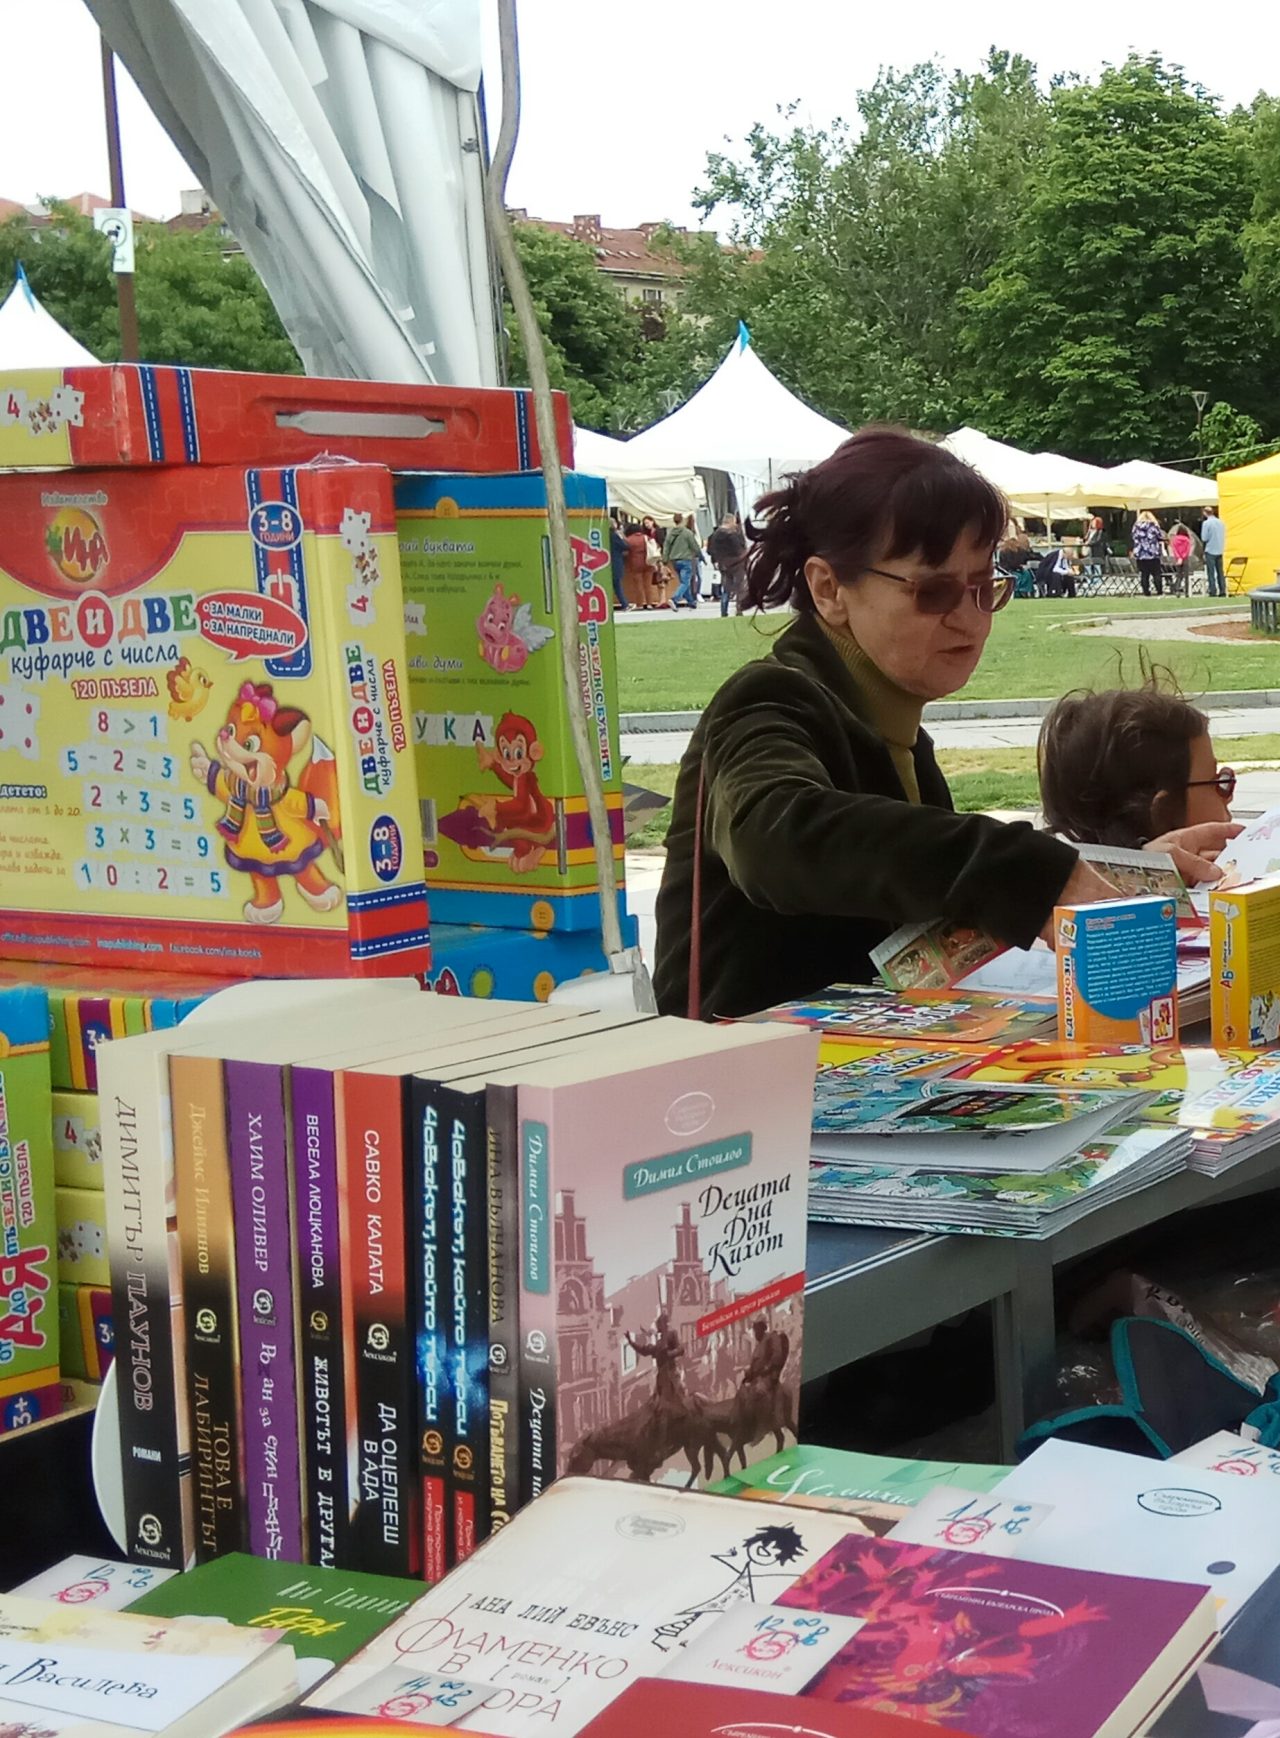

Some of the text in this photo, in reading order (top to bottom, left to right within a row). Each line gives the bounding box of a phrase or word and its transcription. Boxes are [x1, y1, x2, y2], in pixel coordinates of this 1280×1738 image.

[7, 394, 20, 418] 4
[259, 530, 295, 543] ГОДИНИ
[0, 594, 198, 651] ДВЕ И ДВЕ
[211, 603, 263, 622] ЗА МАЛКИ
[351, 595, 369, 613] 4
[211, 622, 296, 647] ЗА НАПРЕДНАЛИ
[12, 644, 180, 681] куфарче с числа
[71, 677, 159, 698] 120 ПЪЗЕЛА
[345, 645, 368, 704] ДВЕ
[367, 658, 379, 702] числа
[383, 660, 406, 751] 120 ПЪЗЕЛА
[359, 737, 383, 795] ДВЕ
[375, 720, 392, 786] куфарче
[0, 784, 47, 799] детето:
[389, 823, 398, 871] ГОДИНИ
[188, 1102, 208, 1183] Джеймс
[633, 1146, 744, 1189] Димил Стоилов
[16, 1142, 34, 1226] 120 ПЪЗЕЛА
[247, 1112, 269, 1273] ХАИМ ОЛИВЕР
[305, 1114, 326, 1289] ВЕСЕЛА ЛЮЦКАНОВА
[527, 1134, 544, 1281] Димил Стоилов
[697, 1172, 792, 1218] Децата
[363, 1129, 385, 1297] САВКО КАЛАТА
[723, 1206, 772, 1249] Дон
[115, 1095, 154, 1412] ДИМИТЪР ПАУНОВ
[707, 1231, 785, 1278] Кихот
[13, 1397, 32, 1429] 3+
[313, 1355, 332, 1456] ЖИВОТЪТ
[193, 1372, 218, 1553] ЛАБИРИНТЪТ
[212, 1421, 233, 1511] ТОВА Е
[318, 1467, 333, 1483] Е
[363, 1440, 380, 1502] В АДА
[377, 1402, 400, 1545] ДА ОЦЕЛЕЕШ
[317, 1492, 335, 1570] ДРУГА
[393, 1592, 630, 1681] ФЛАМЕНКО
[468, 1595, 640, 1639] АНА ЛИЙ ЕВЪНС
[5, 1657, 159, 1699] Василева
[437, 1651, 473, 1675] В
